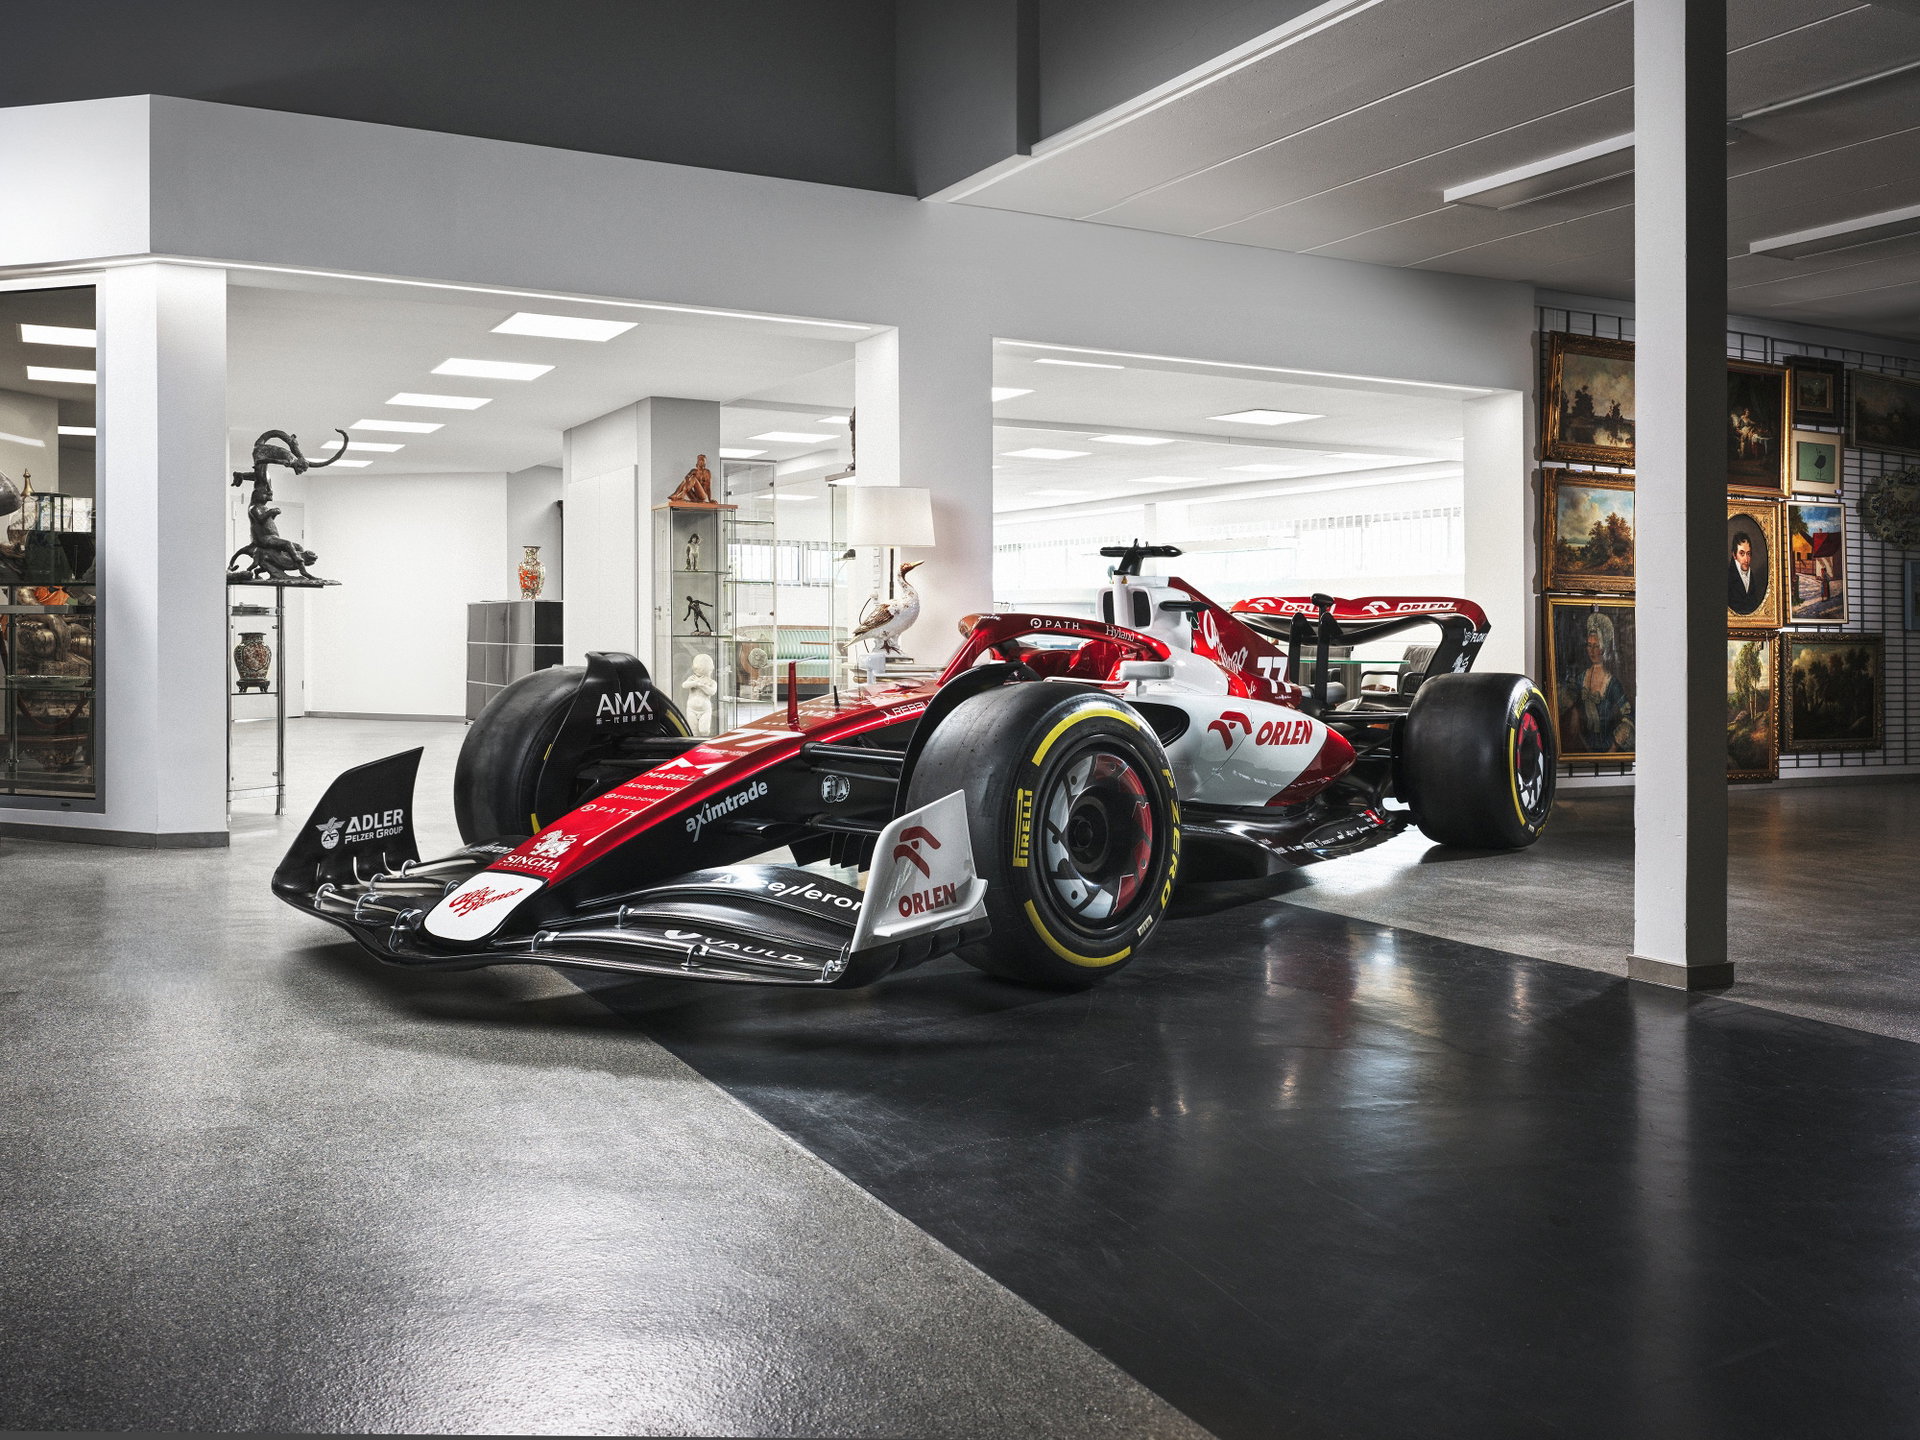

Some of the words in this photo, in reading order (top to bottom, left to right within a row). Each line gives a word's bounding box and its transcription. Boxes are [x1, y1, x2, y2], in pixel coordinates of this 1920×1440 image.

[1105, 625, 1134, 642] Hyland
[1257, 656, 1292, 694] 77
[596, 690, 653, 717] AMX
[892, 700, 930, 716] REBEL
[1255, 720, 1313, 746] ORLEN
[643, 771, 702, 782] MARELL
[345, 809, 404, 834] ADLER
[596, 805, 640, 817] PATH
[685, 781, 768, 842] aximtrade
[1013, 788, 1033, 867] PIRELLI
[502, 855, 560, 870] SINGHA
[1160, 803, 1181, 910] ZERO
[898, 882, 957, 918] ORLEN
[704, 937, 805, 962] VAULD
